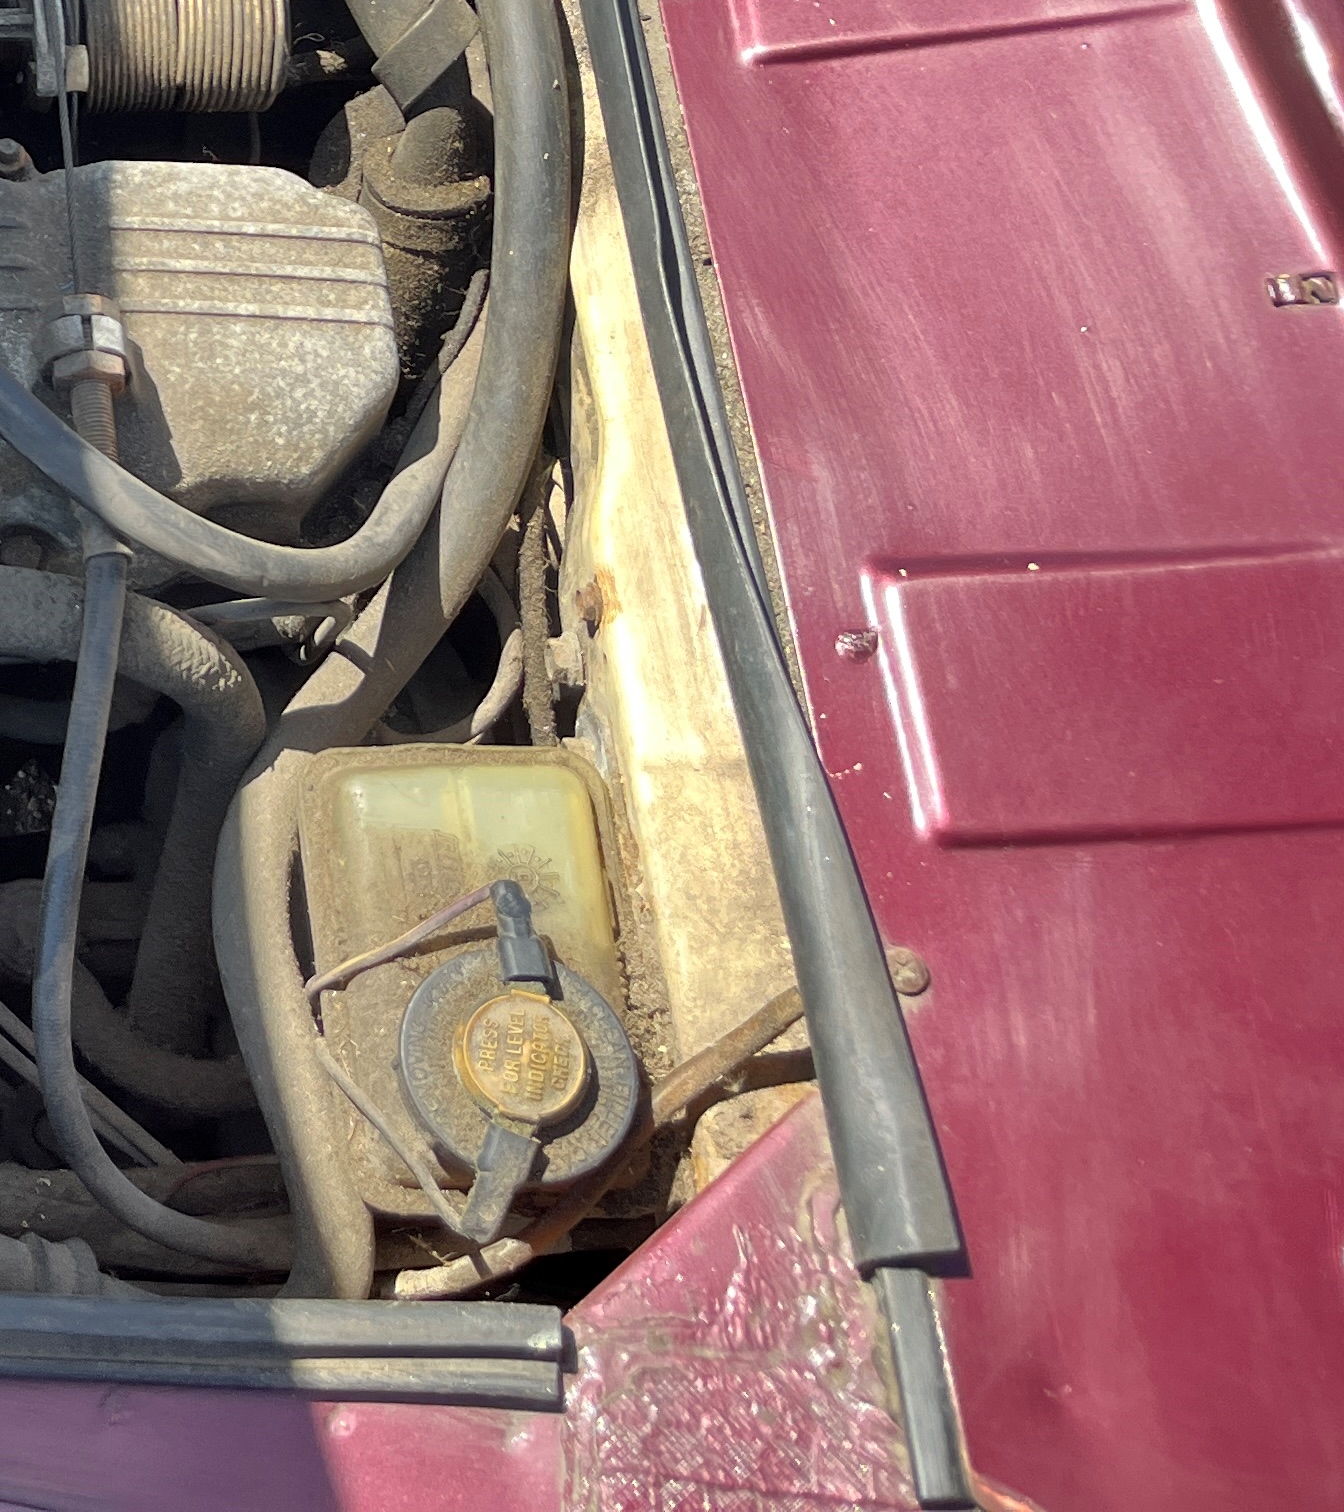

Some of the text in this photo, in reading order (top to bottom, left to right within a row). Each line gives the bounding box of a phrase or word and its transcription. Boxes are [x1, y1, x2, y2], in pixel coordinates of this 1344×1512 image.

[478, 1018, 501, 1072] PRESS
[499, 1007, 527, 1096] FOR LEVEL
[525, 1013, 552, 1102] INDICATOR
